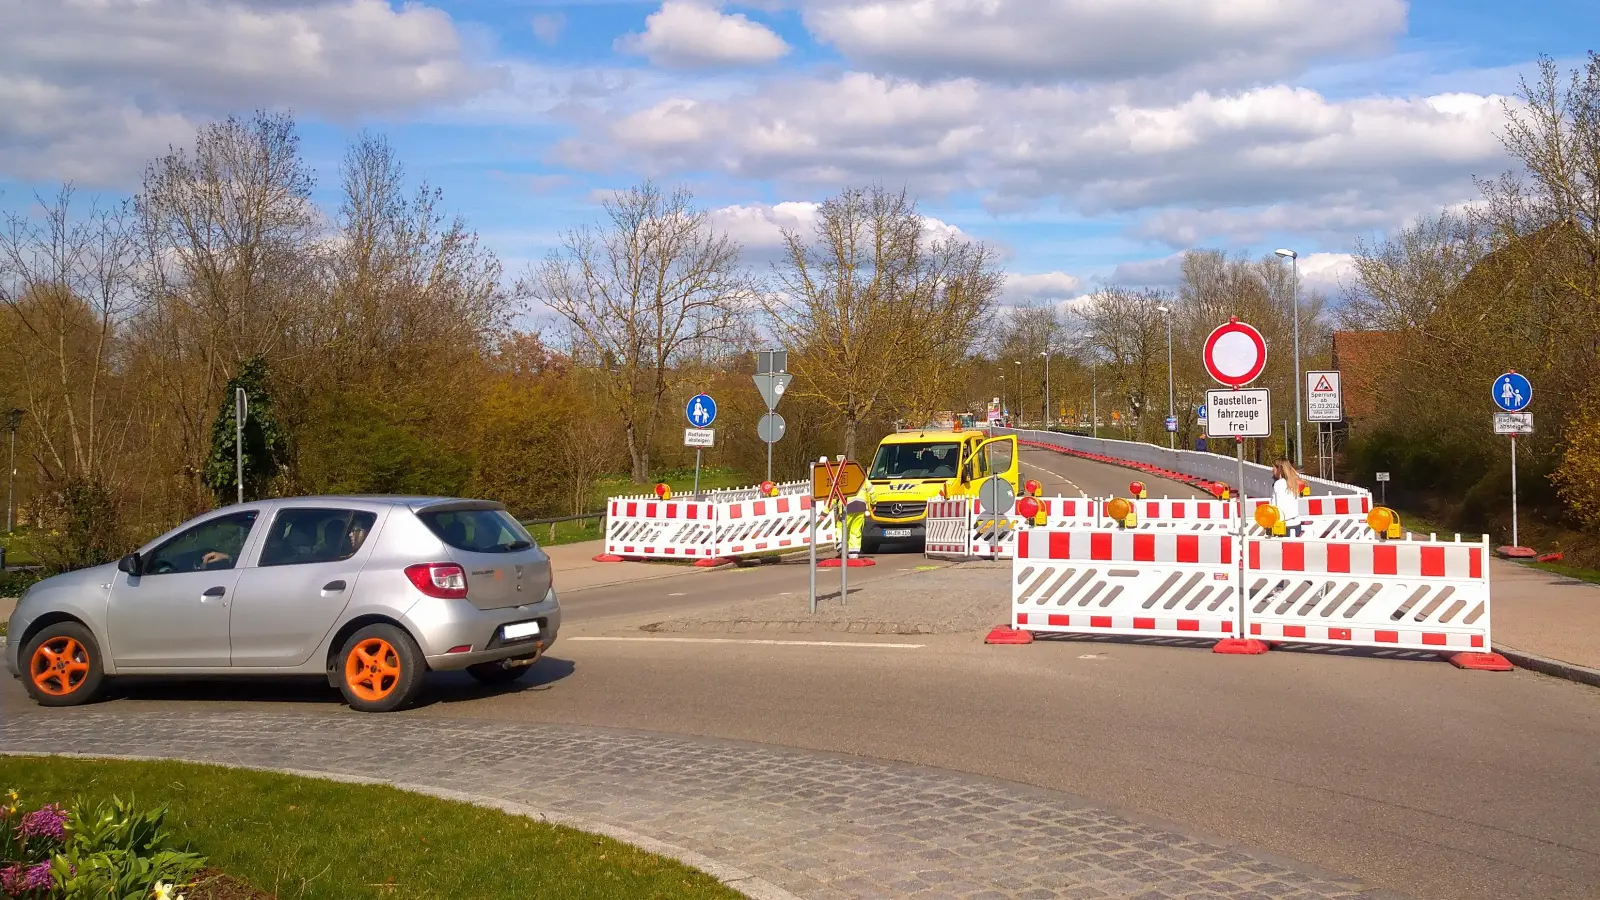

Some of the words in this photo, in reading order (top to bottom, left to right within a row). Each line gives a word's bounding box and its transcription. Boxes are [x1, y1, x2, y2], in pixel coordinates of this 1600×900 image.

[1213, 395, 1263, 406] Baustellen-
[1217, 408, 1259, 420] fahrzeuge
[1228, 421, 1248, 431] frei
